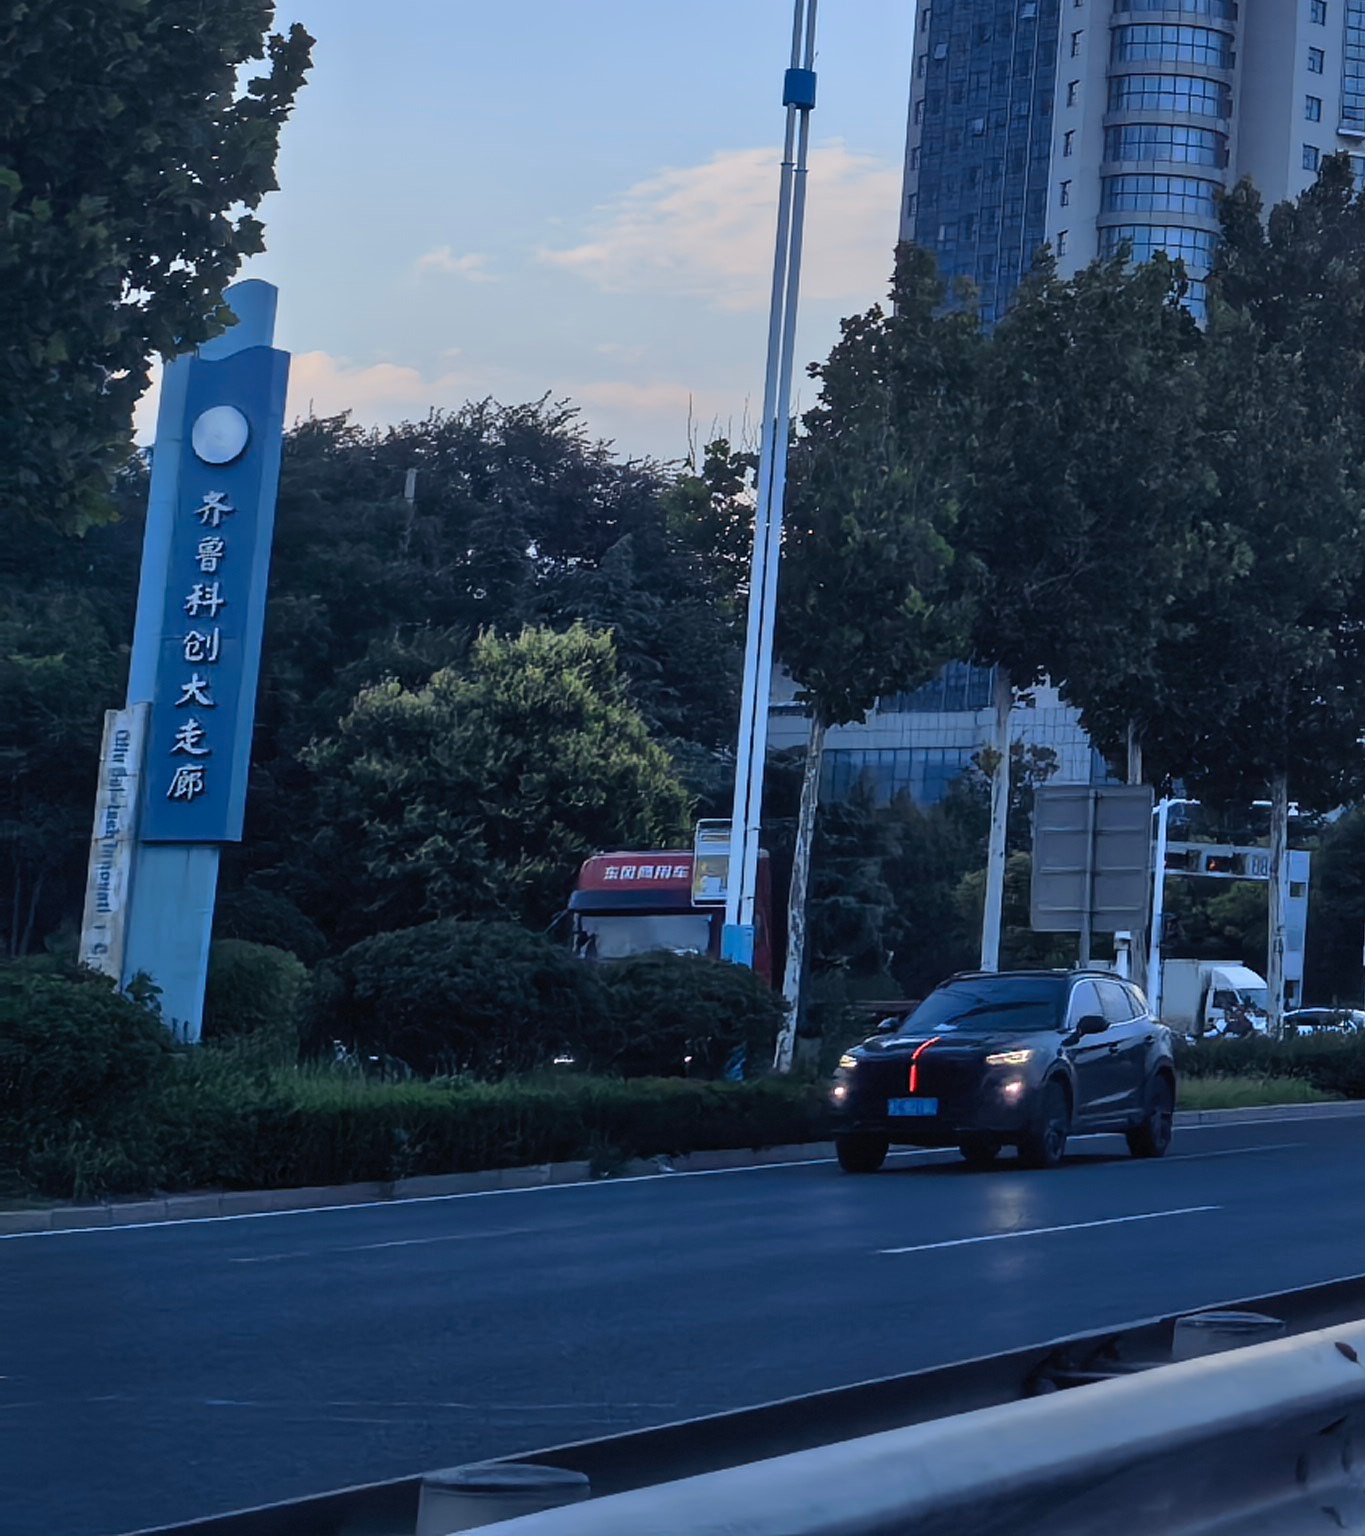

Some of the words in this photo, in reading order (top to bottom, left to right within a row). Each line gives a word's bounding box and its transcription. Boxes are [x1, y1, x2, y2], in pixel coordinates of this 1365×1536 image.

[166, 490, 235, 800] 齐鲁科创大走廊
[604, 865, 688, 880] 东风商用车
